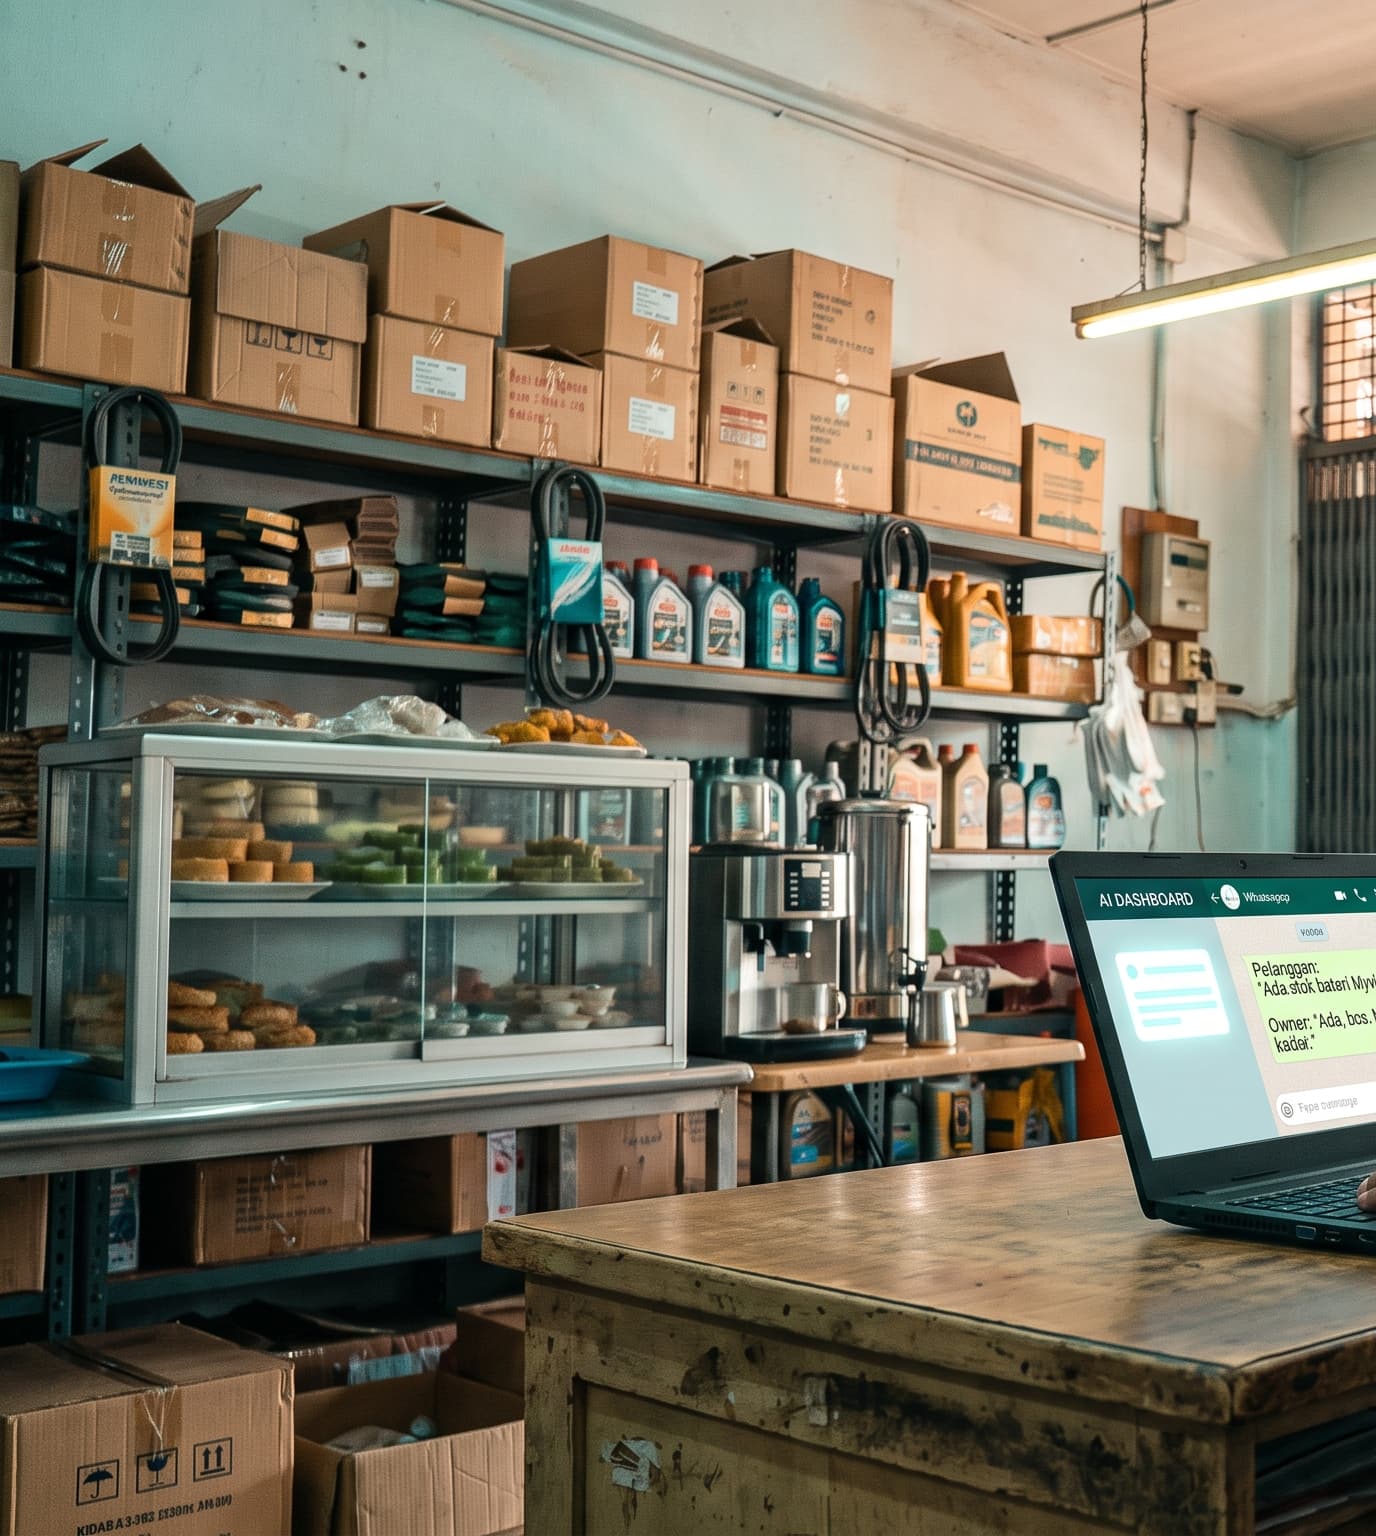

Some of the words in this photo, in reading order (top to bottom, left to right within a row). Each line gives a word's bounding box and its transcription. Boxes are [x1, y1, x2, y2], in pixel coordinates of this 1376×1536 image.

[1100, 893, 1113, 907] AI
[1114, 892, 1194, 907] DASHBOARD
[1252, 961, 1320, 979] Pelanggan:
[1315, 975, 1352, 994] bateri
[1268, 1017, 1313, 1033] Owner:
